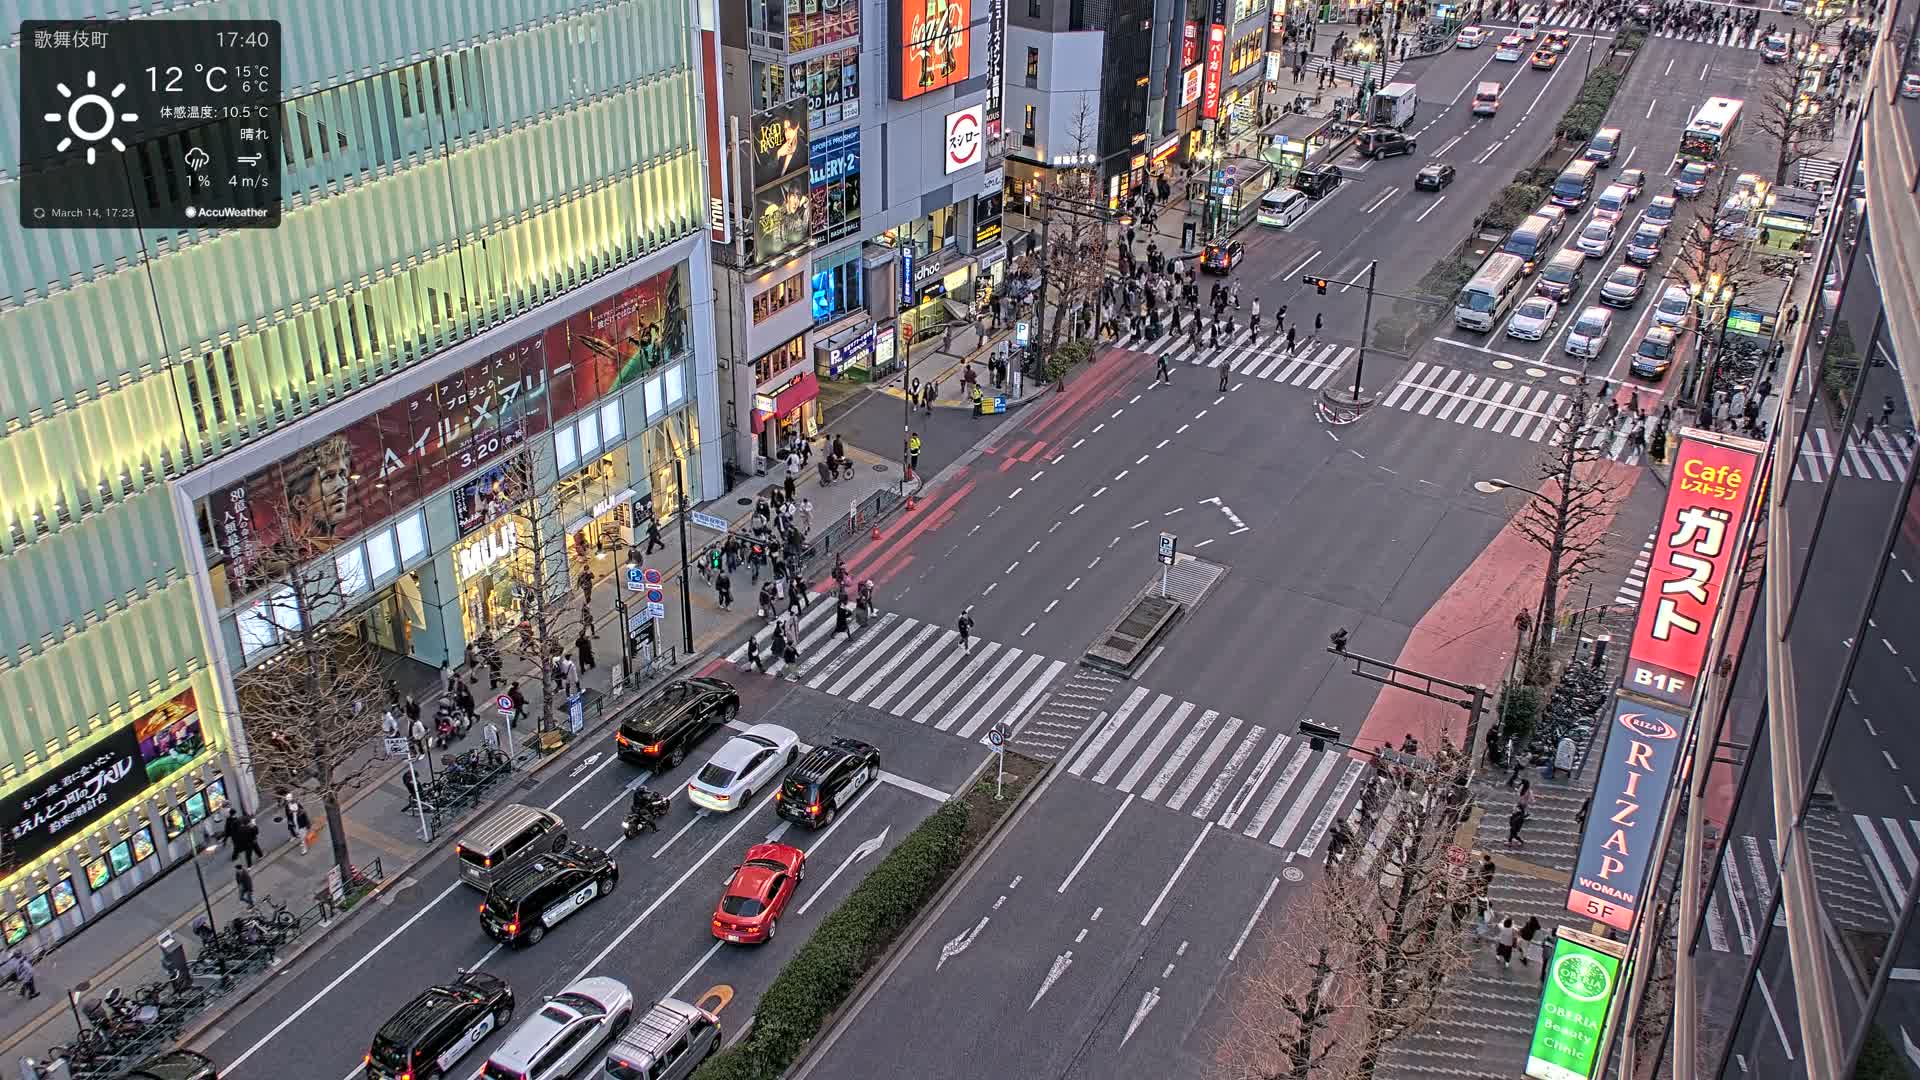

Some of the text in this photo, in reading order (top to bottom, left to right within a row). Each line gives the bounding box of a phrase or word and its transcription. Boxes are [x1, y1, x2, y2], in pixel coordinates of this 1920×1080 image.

[1206, 44, 1221, 109] バーガーキング
[949, 132, 980, 150] スシロー
[711, 197, 724, 231] MUJI
[447, 376, 504, 411] プロジェクト
[461, 437, 499, 468] 3.20
[1684, 459, 1742, 487] Café
[1680, 478, 1737, 501] レストラン
[593, 495, 617, 518] MUJI
[459, 521, 517, 581] MUJI
[1161, 537, 1170, 547] P
[1652, 508, 1730, 640] ガスト
[1634, 668, 1685, 693] B1F
[1632, 718, 1665, 733] RIZAP
[1598, 740, 1655, 880] RIZAP
[1579, 877, 1634, 904] WOMAN
[1586, 900, 1615, 919] 5F
[1560, 968, 1602, 990] OBERIA
[1544, 1002, 1599, 1031] OBERIA
[1544, 1019, 1592, 1046] Beauty
[1543, 1037, 1585, 1060] Clinic
